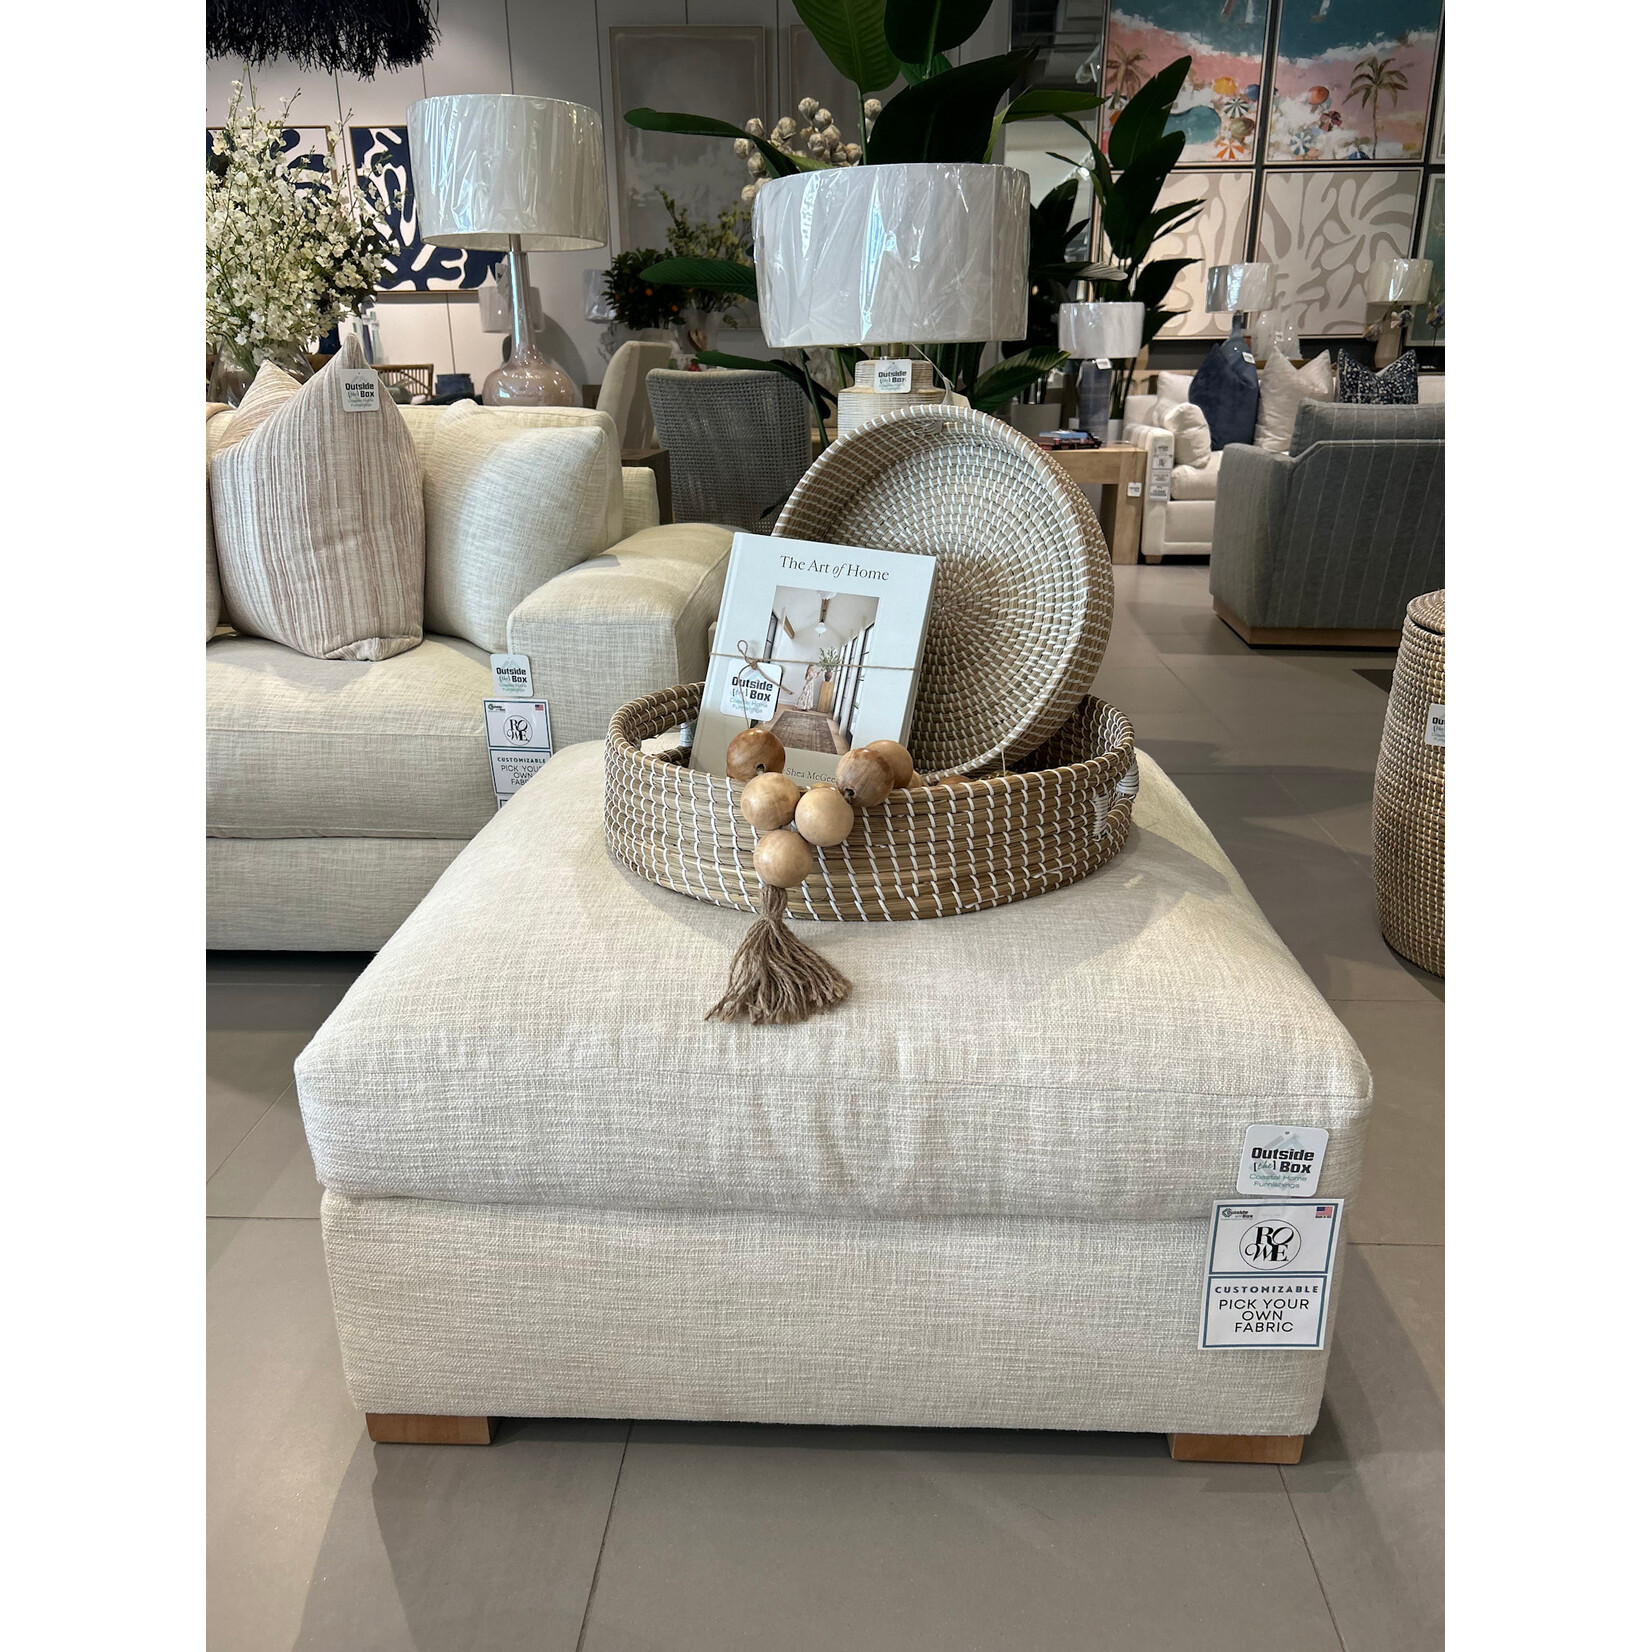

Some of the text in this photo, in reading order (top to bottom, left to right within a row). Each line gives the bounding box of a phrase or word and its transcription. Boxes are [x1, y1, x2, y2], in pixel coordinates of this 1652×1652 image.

[345, 382, 375, 390] Outside
[780, 555, 890, 581] The Art of Home
[496, 667, 527, 676] Outside
[511, 675, 528, 683] Box
[732, 676, 773, 692] Outside
[749, 690, 771, 702] Box
[497, 756, 546, 764] CUSTOMIZABLE
[513, 771, 533, 779] OWN
[785, 767, 836, 783] Shea McGee
[1251, 1147, 1315, 1161] Outside
[1280, 1161, 1312, 1174] Box
[1214, 1285, 1319, 1294] CUSTOMIZABLE
[1218, 1299, 1310, 1310] PICK YOUR
[1241, 1310, 1284, 1321] OWN
[1234, 1321, 1294, 1333] FABRIC
